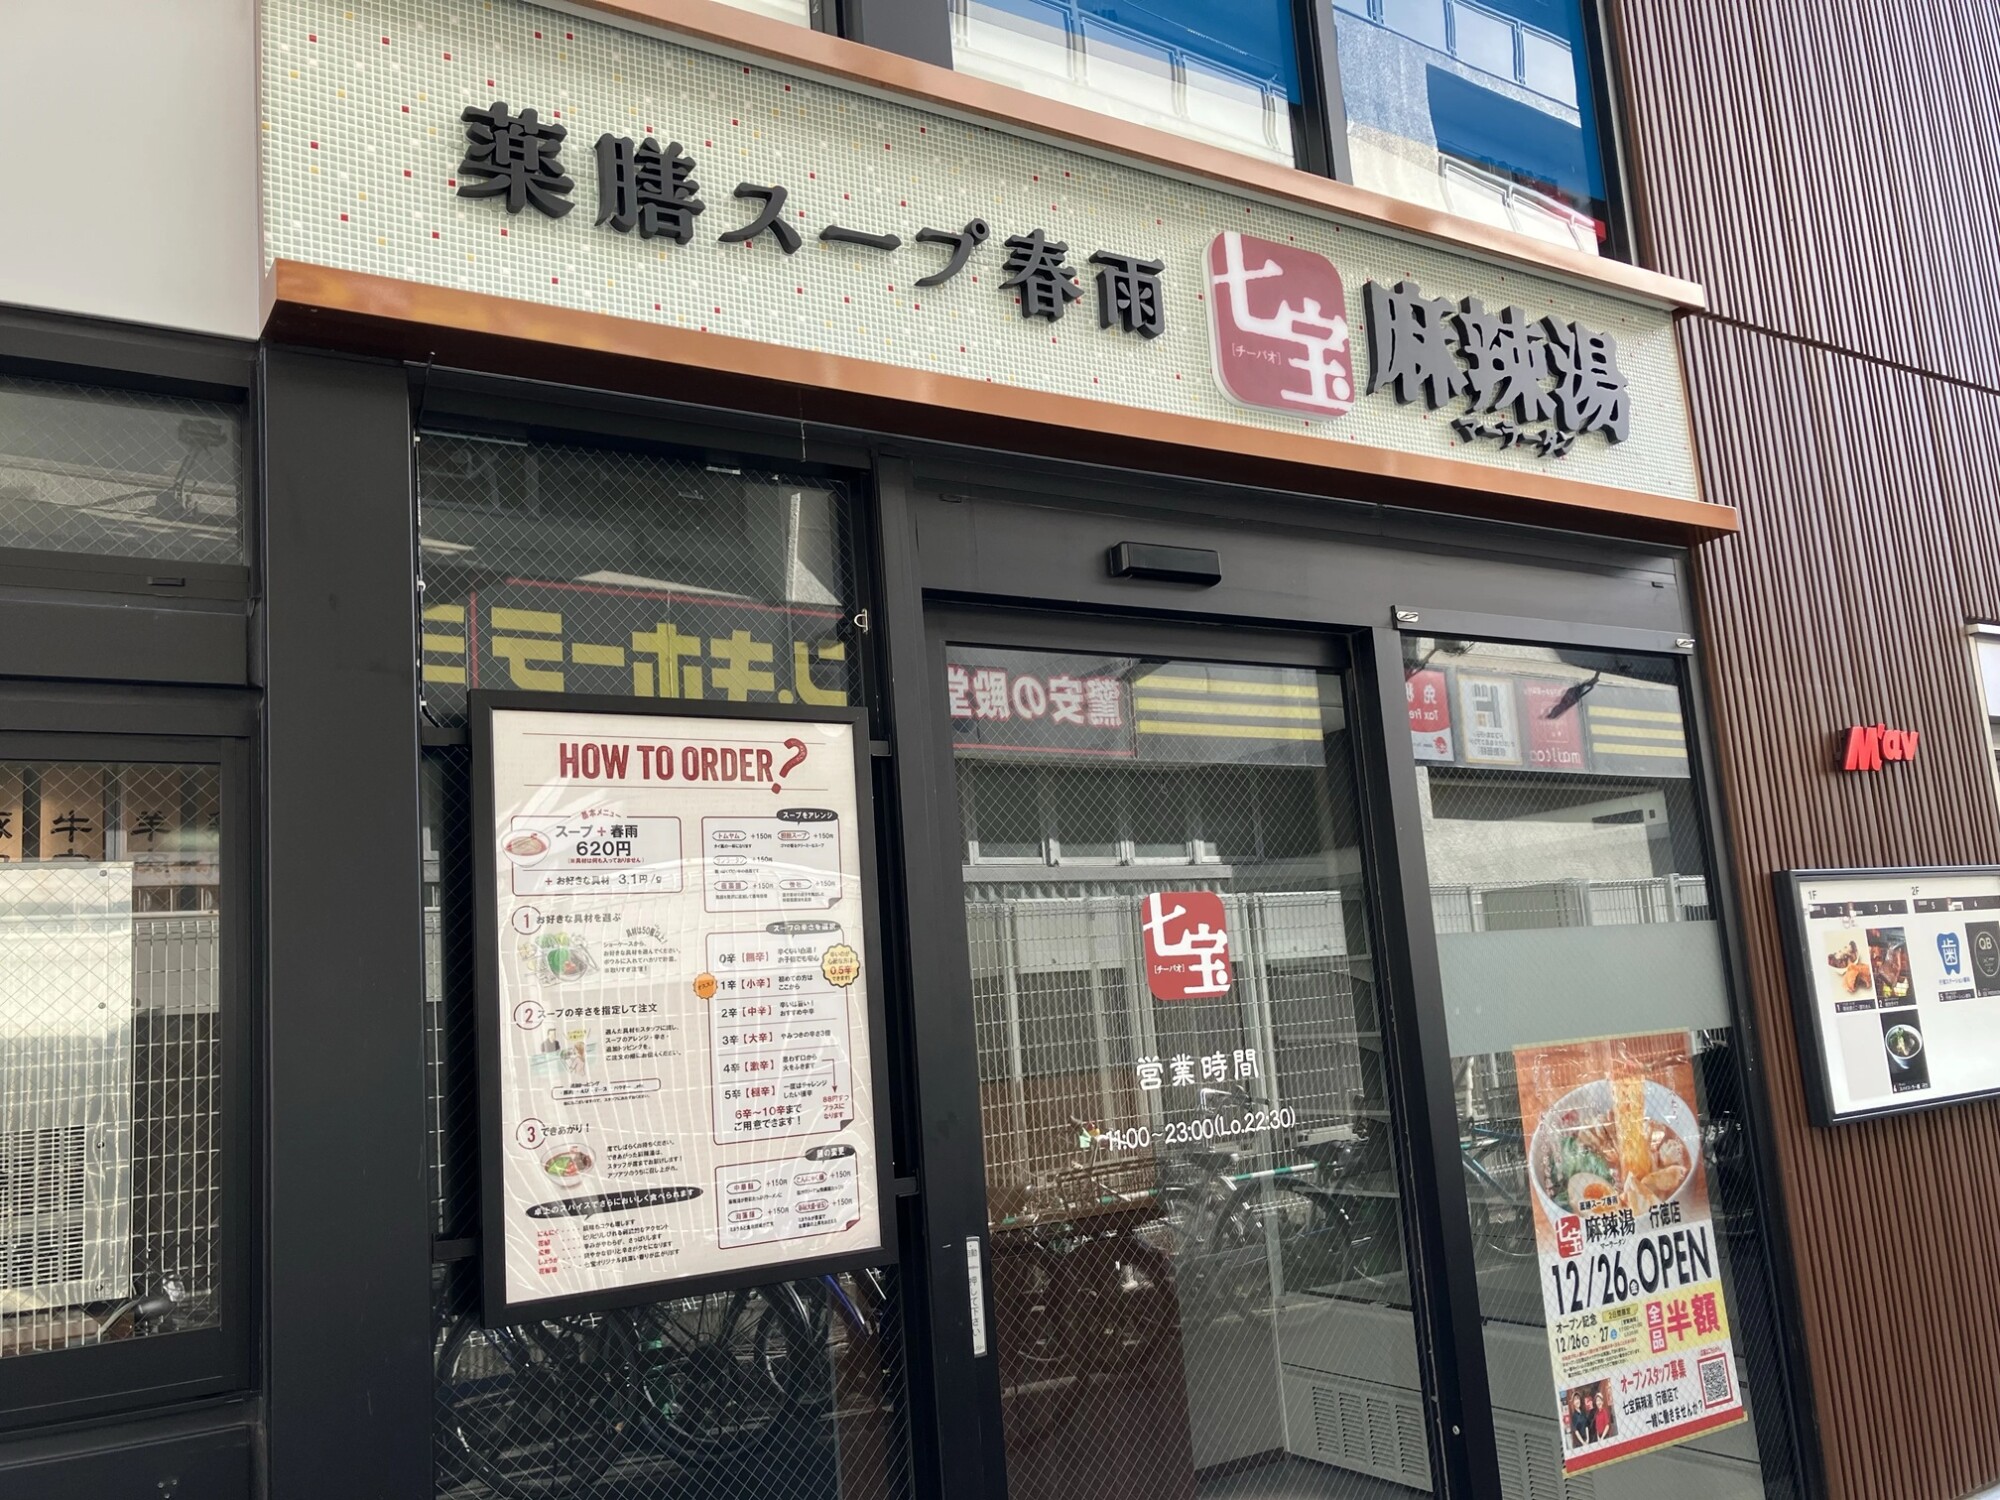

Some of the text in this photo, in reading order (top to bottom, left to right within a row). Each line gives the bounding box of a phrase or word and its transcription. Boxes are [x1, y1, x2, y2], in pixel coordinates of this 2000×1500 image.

[456, 100, 1166, 340] 薬膳スープ春雨
[1211, 230, 1354, 413] 七宝
[1363, 280, 1630, 444] 麻辣湯
[559, 743, 630, 780] HOW
[637, 745, 675, 780] TO
[782, 811, 834, 820] スープをアレンジ
[576, 840, 632, 857] 620円
[536, 913, 622, 925] お好きな具材を選ぶ
[1143, 893, 1230, 995] 七宝
[1941, 938, 1957, 966] 歯
[1978, 937, 1993, 951] QB
[538, 1002, 658, 1020] スープの辛さを指定して注文
[1136, 1048, 1259, 1091] 営業時間
[1585, 1208, 1636, 1244] 麻辣湯
[1648, 1200, 1681, 1229] 行徳店
[1552, 1250, 1629, 1315] 12/26
[1637, 1227, 1712, 1294] OPEN
[1555, 1312, 1598, 1334] オープン記念
[1667, 1291, 1721, 1342] 半額
[1620, 1359, 1687, 1394] オープンスタッフ募集
